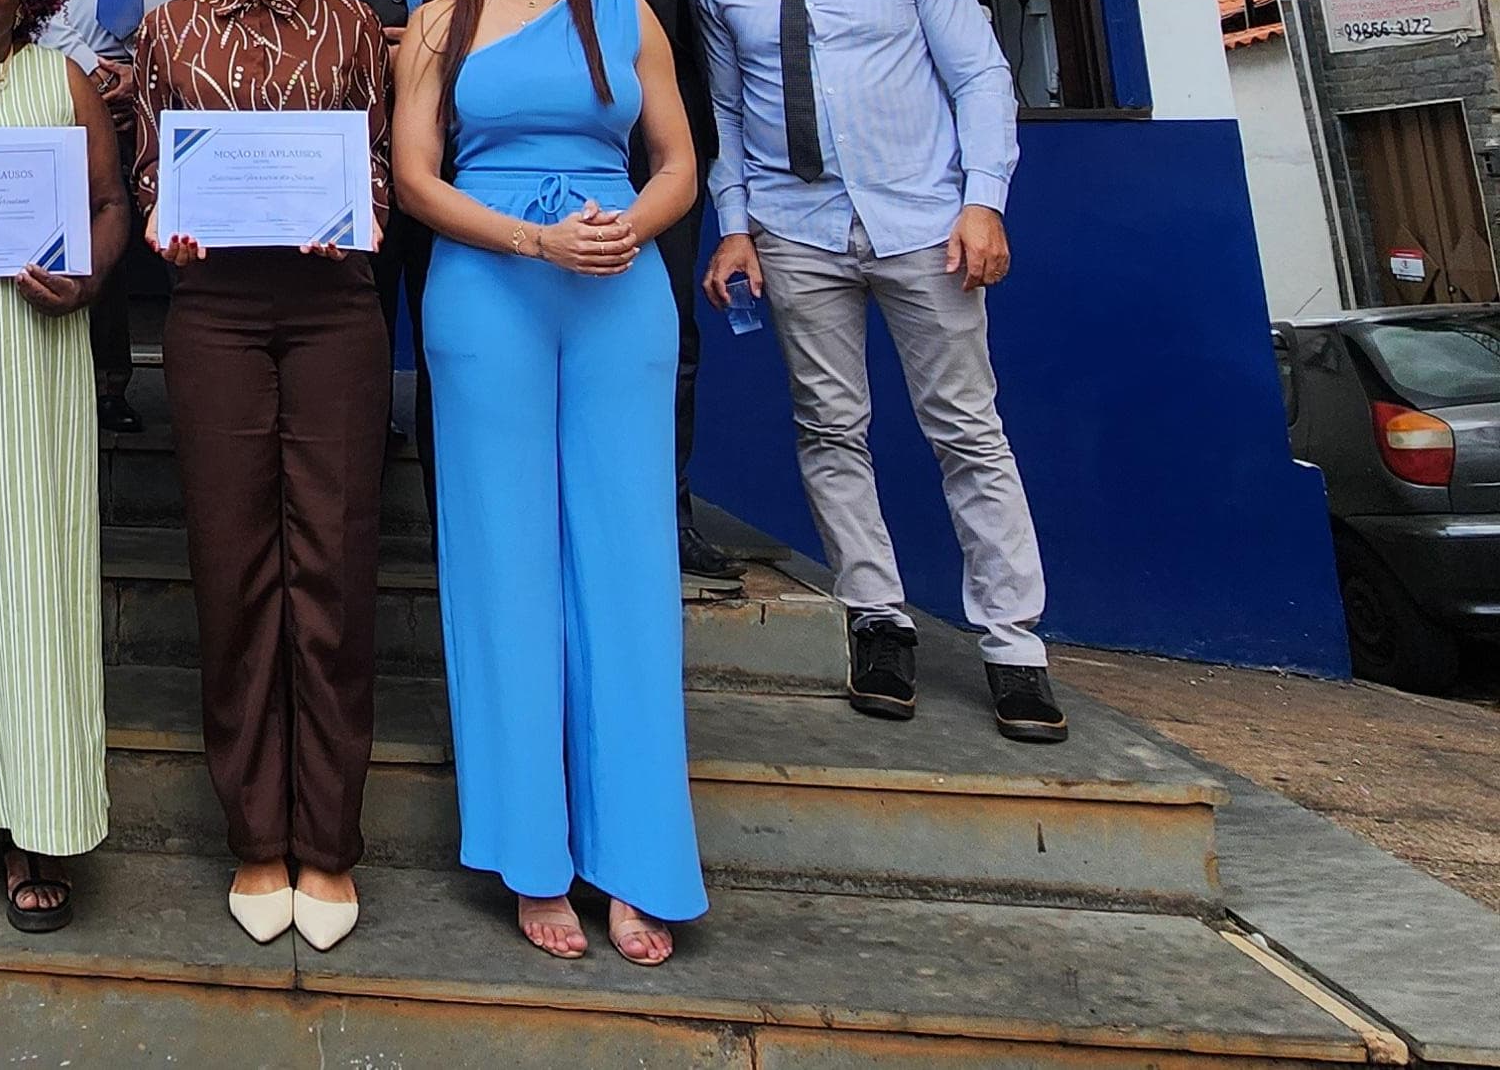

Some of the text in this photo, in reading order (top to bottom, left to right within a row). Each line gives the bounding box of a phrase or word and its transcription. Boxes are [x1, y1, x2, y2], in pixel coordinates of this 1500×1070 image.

[214, 148, 322, 160] MOÇÃO DE APLAUSOS
